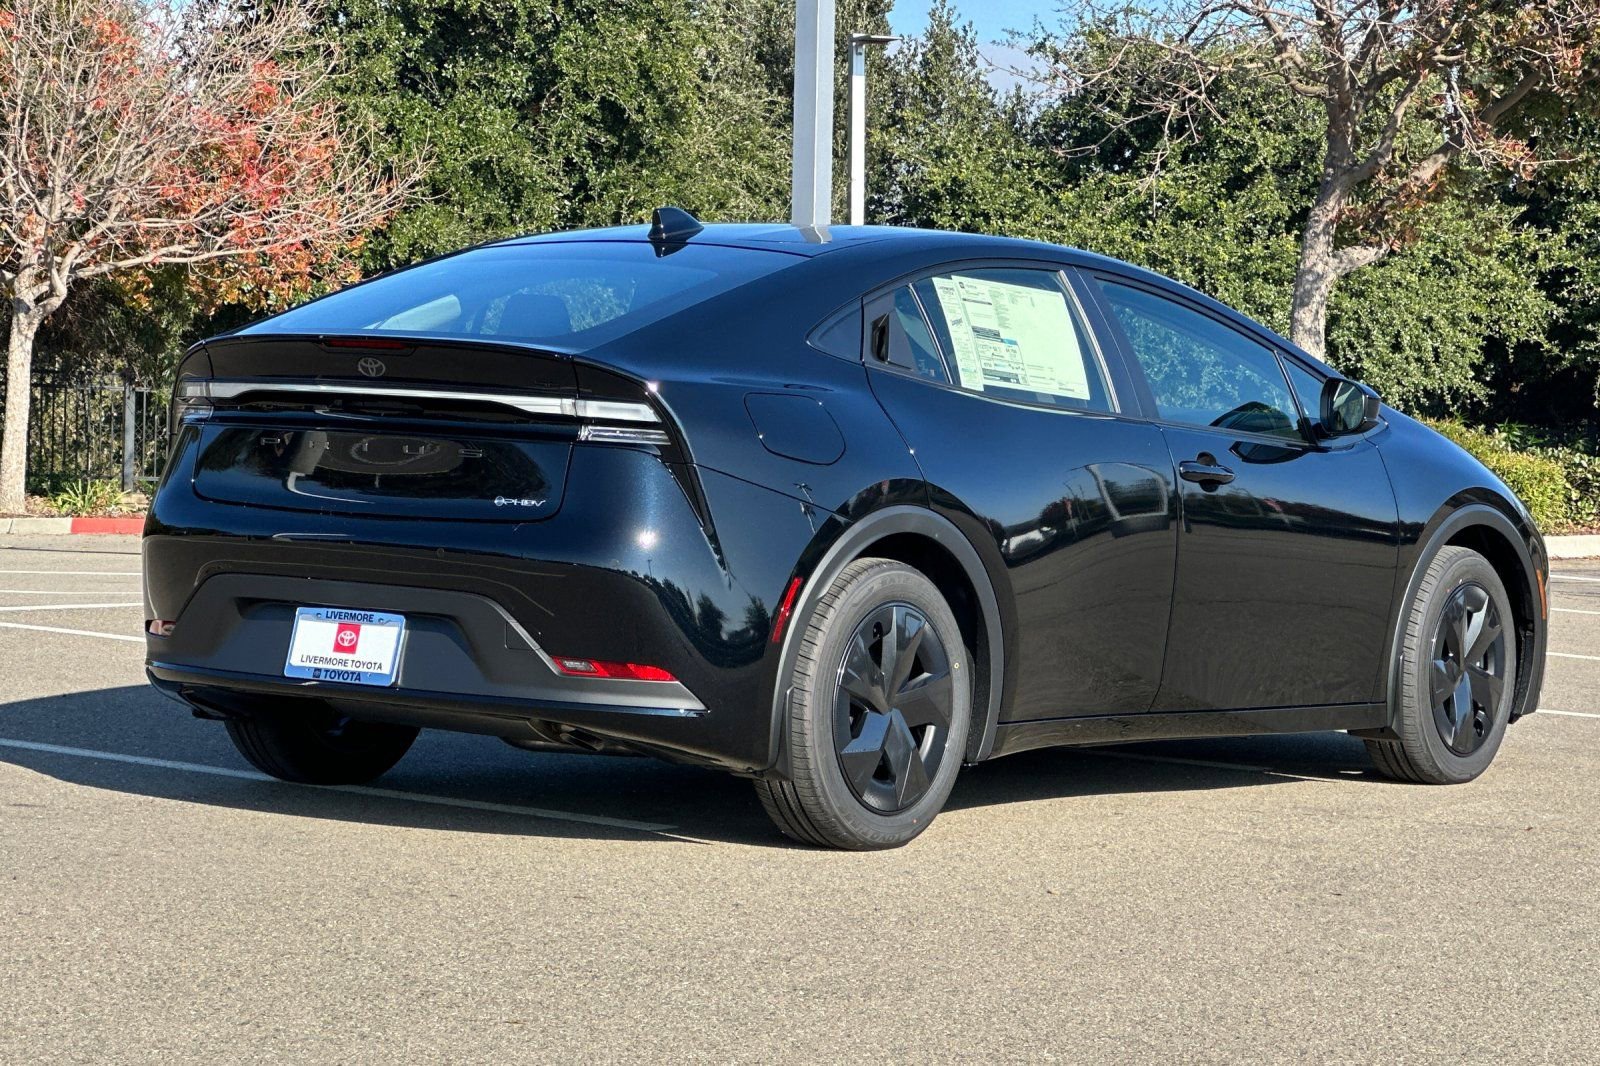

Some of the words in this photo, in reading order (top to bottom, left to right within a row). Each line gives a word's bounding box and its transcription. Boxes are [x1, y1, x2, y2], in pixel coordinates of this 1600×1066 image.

[325, 610, 375, 623] LIVERMORE
[300, 654, 349, 668] LIVERMORE
[350, 659, 383, 671] TOYOTA
[323, 669, 361, 682] TOYOTA
